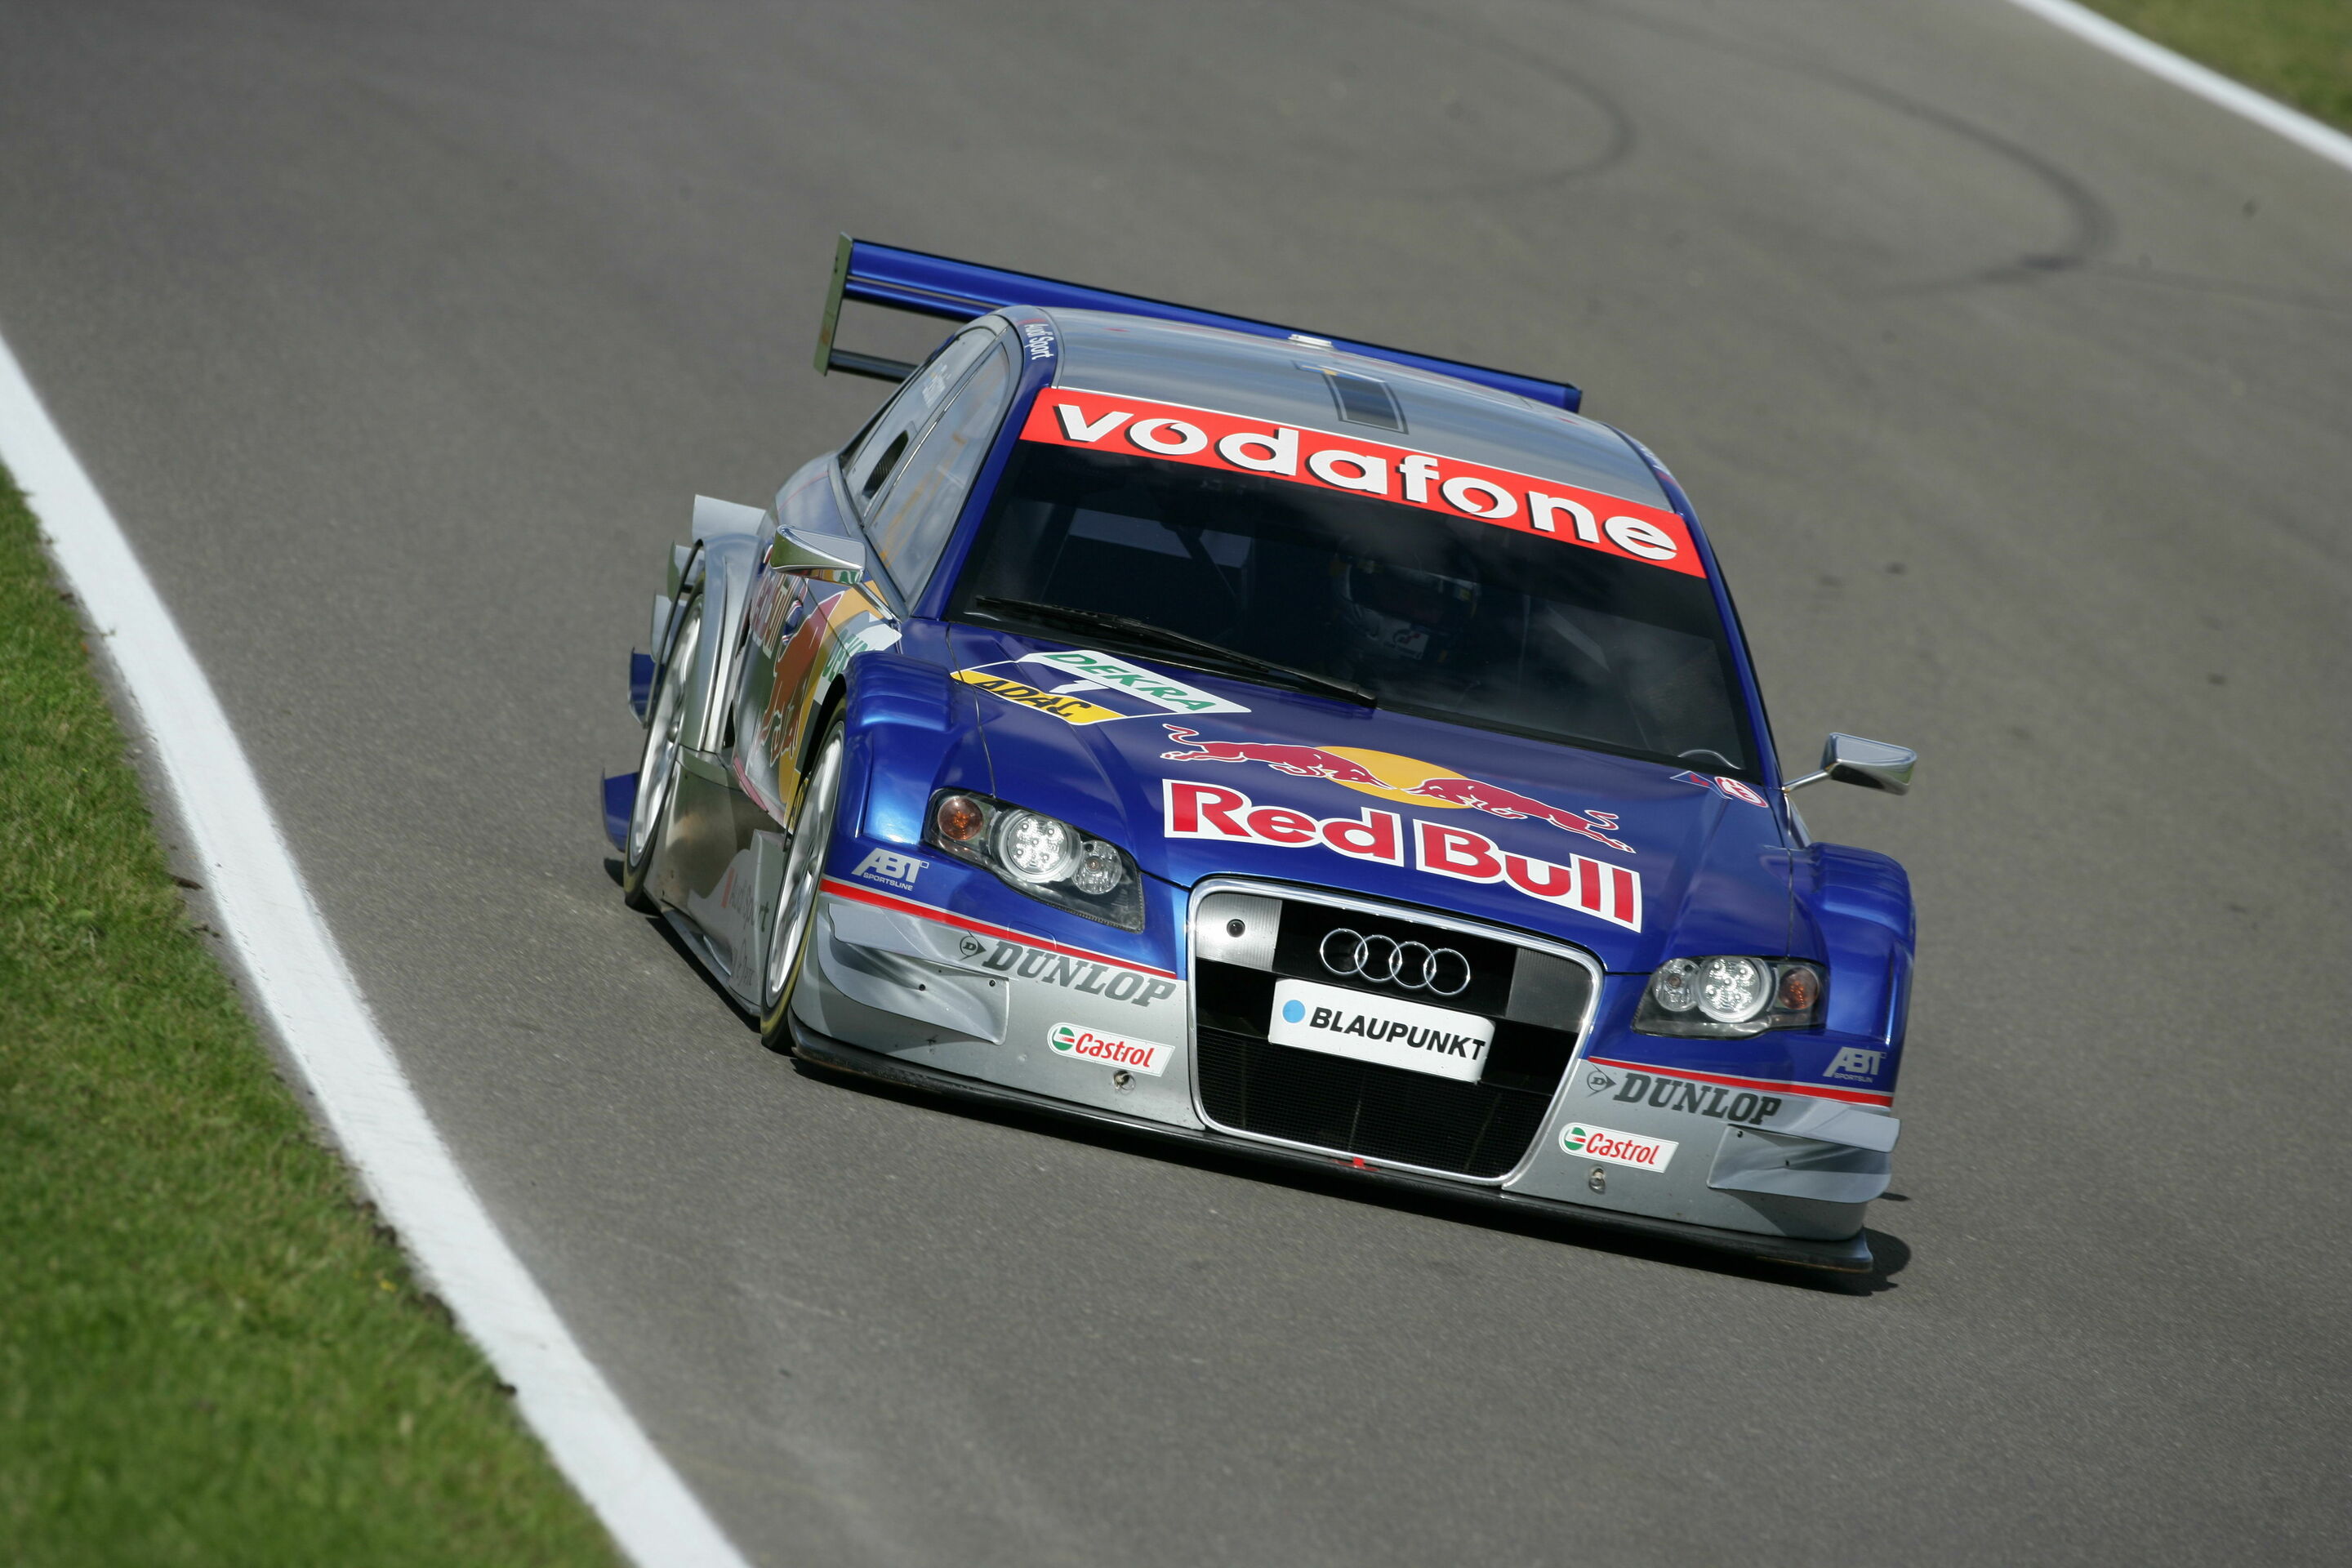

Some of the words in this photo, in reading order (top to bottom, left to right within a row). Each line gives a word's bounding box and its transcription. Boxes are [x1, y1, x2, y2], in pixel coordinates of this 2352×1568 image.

[1024, 335, 1055, 360] Sport
[1054, 403, 1678, 561] vodafone
[973, 679, 1093, 718] ADAC
[1041, 653, 1218, 712] DEKRA
[851, 847, 922, 884] ABT
[1162, 778, 1405, 867] Red
[1414, 817, 1642, 933] Bull
[862, 871, 914, 892] SPORTSLINE
[981, 940, 1177, 1008] DUNLOP
[1075, 1032, 1155, 1068] Castrol
[1309, 1006, 1486, 1061] BLAUPUNKT
[1822, 1046, 1882, 1078] ABT
[1613, 1072, 1783, 1125] DUNLOP
[1586, 1133, 1660, 1165] Castrol
